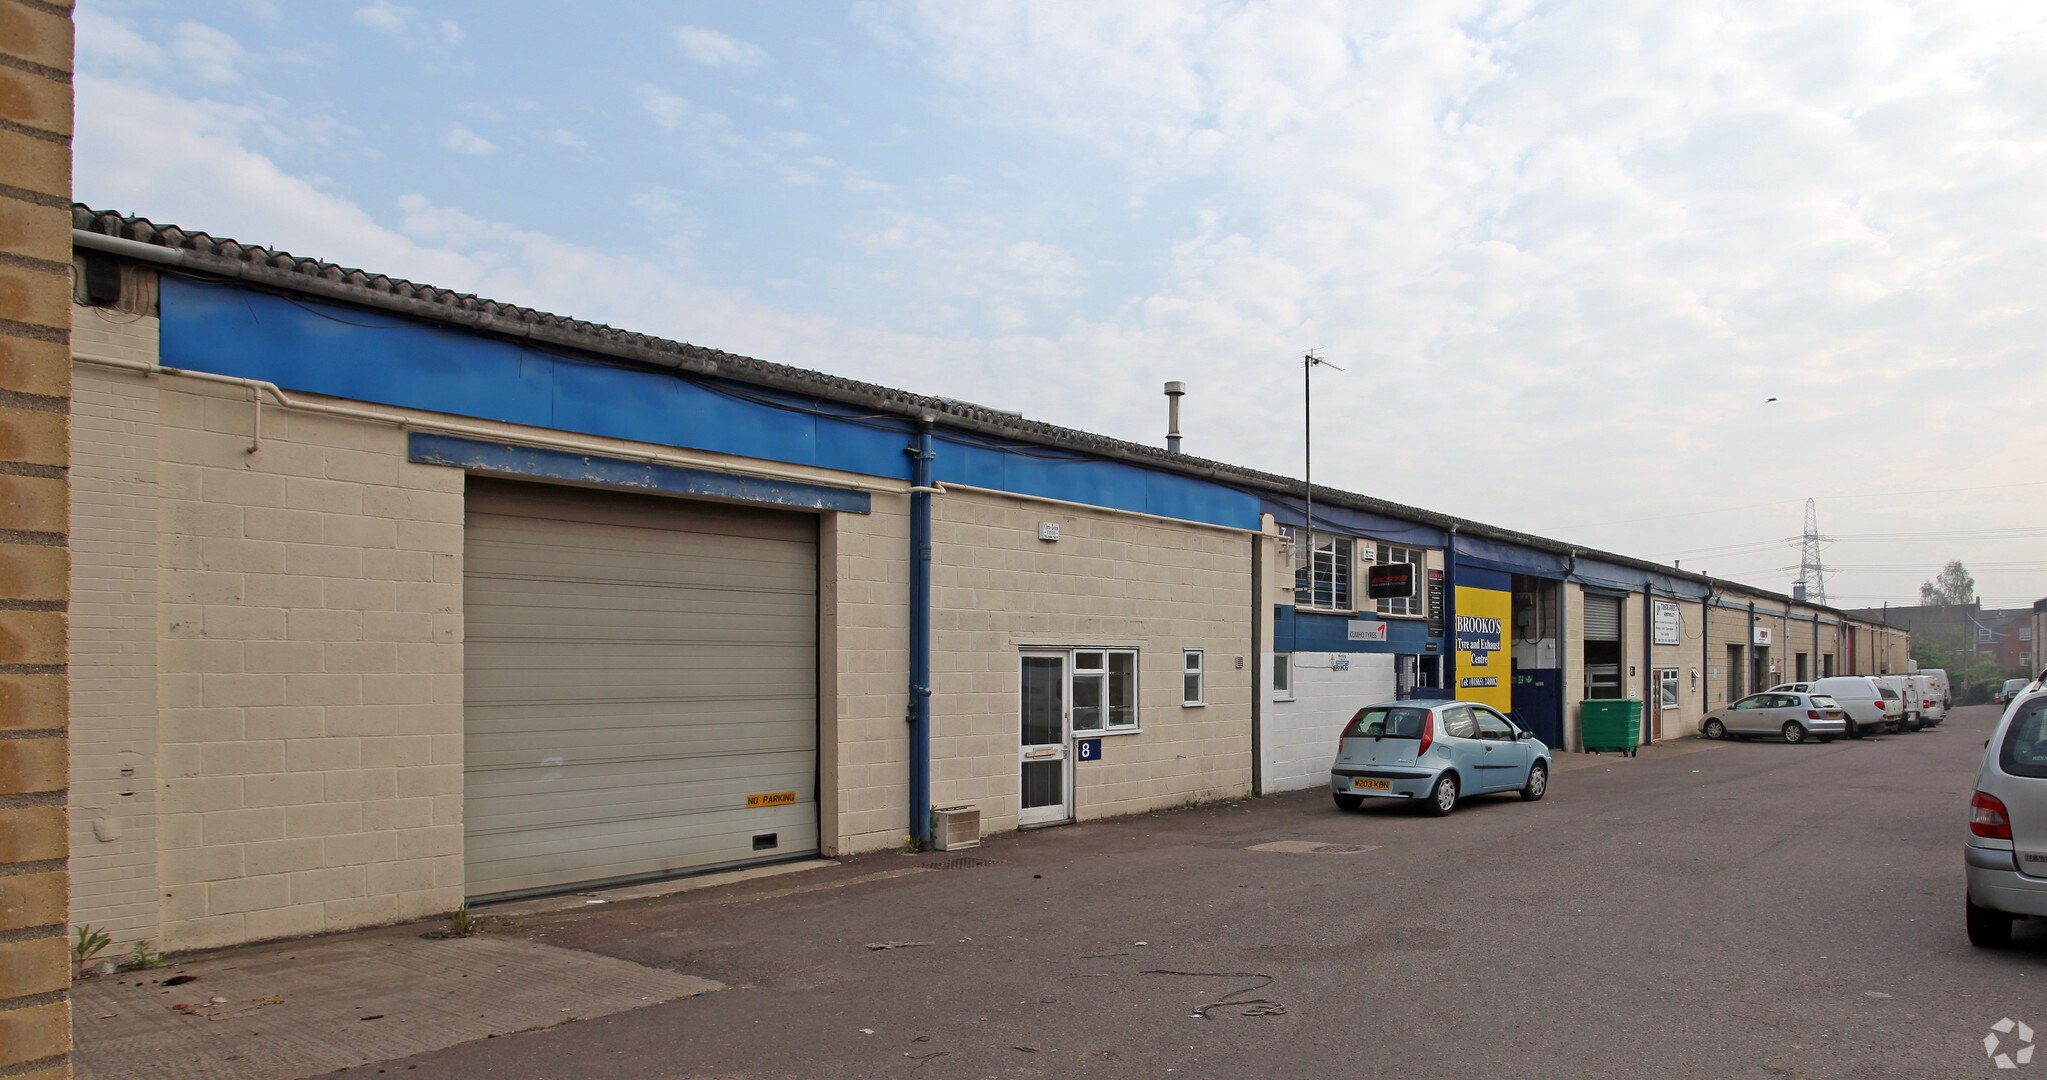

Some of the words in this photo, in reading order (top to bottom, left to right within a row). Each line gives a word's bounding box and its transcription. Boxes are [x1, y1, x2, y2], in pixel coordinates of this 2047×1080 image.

[1457, 616, 1502, 634] BROOKO'S
[1365, 631, 1377, 639] TYRES
[1458, 638, 1469, 651] Tyre
[1470, 639, 1480, 649] and
[1481, 639, 1500, 650] Exhaust
[1471, 653, 1488, 664] Centre
[1082, 743, 1090, 758] 8
[1373, 780, 1390, 789] KBN
[747, 796, 759, 805] NO
[762, 793, 795, 803] PARKING
